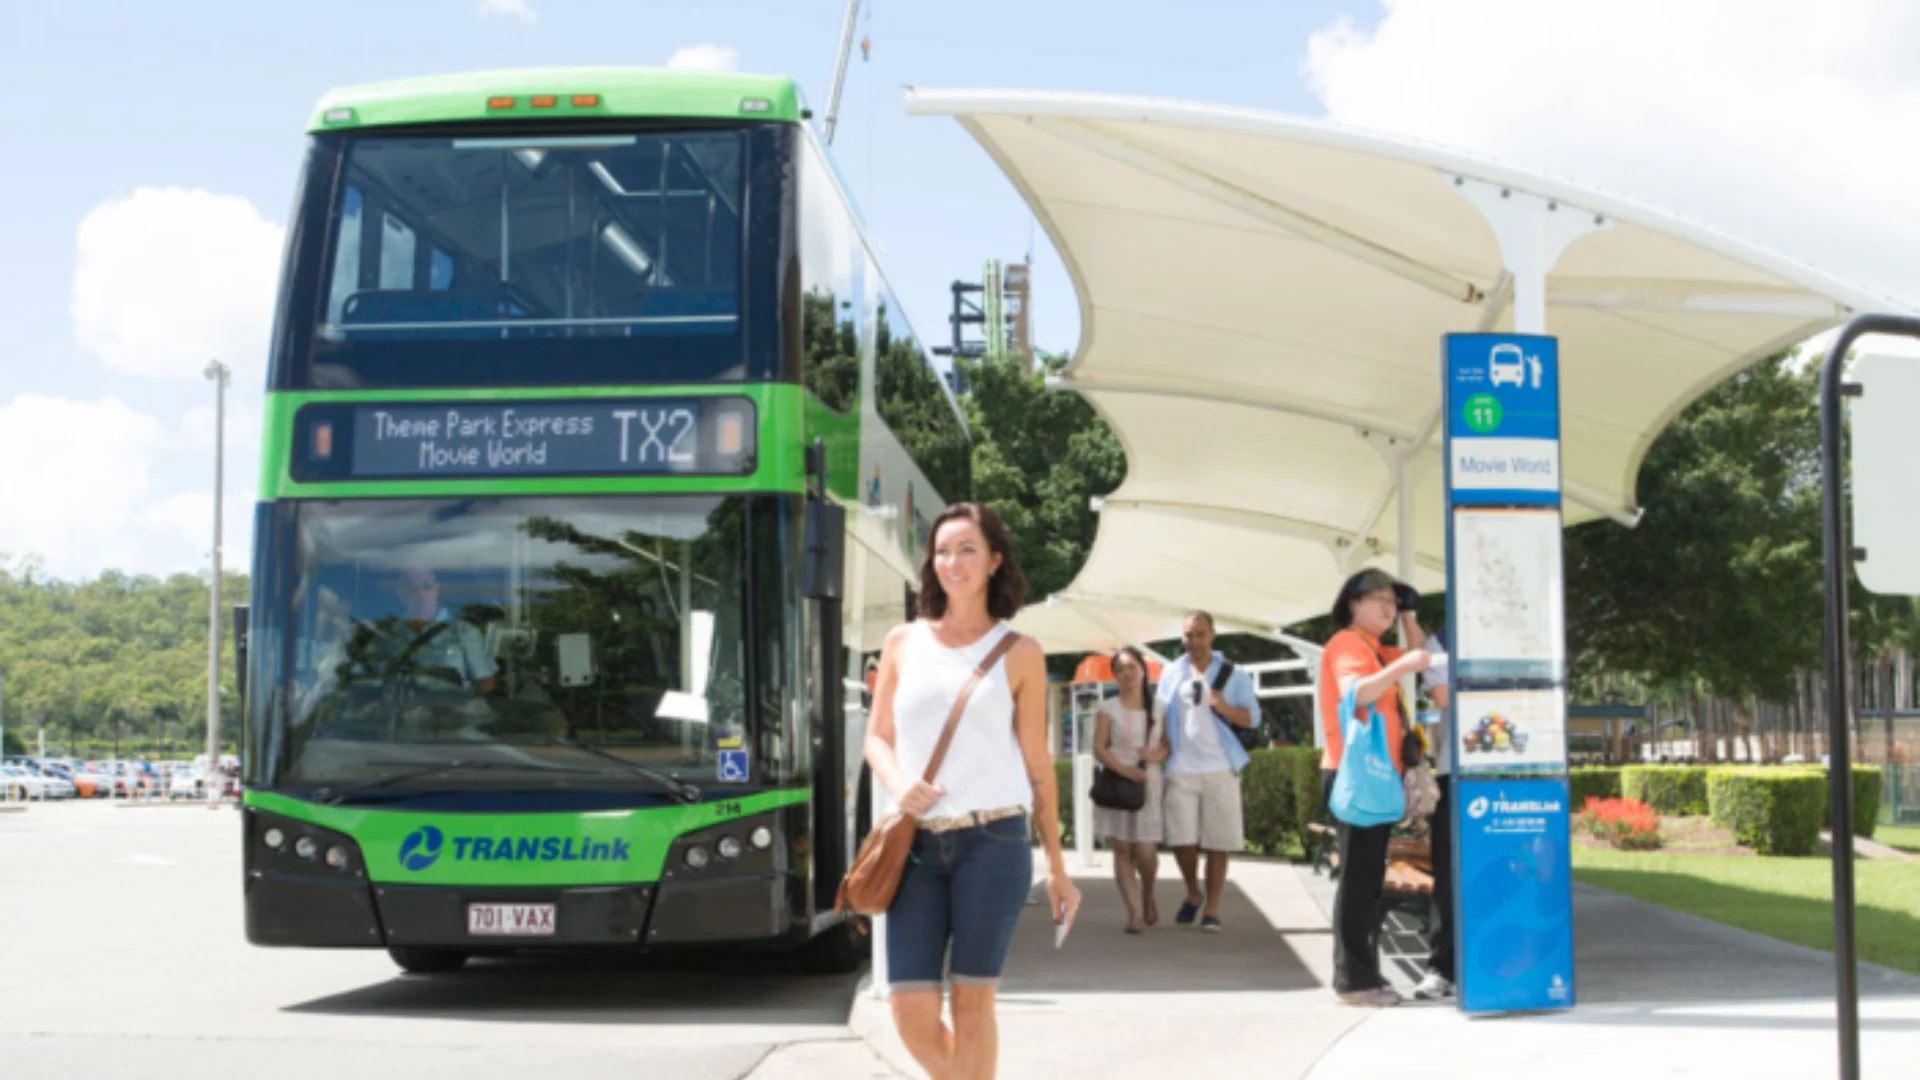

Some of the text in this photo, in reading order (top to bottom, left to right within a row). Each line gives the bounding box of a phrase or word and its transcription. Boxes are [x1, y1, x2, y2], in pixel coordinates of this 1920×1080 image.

[375, 409, 594, 438] Theme Park Express
[1472, 407, 1493, 426] 11
[612, 408, 695, 463] TX2
[419, 440, 547, 469] Movie World
[1459, 456, 1551, 475] Movie World
[451, 837, 631, 863] TRANSLink
